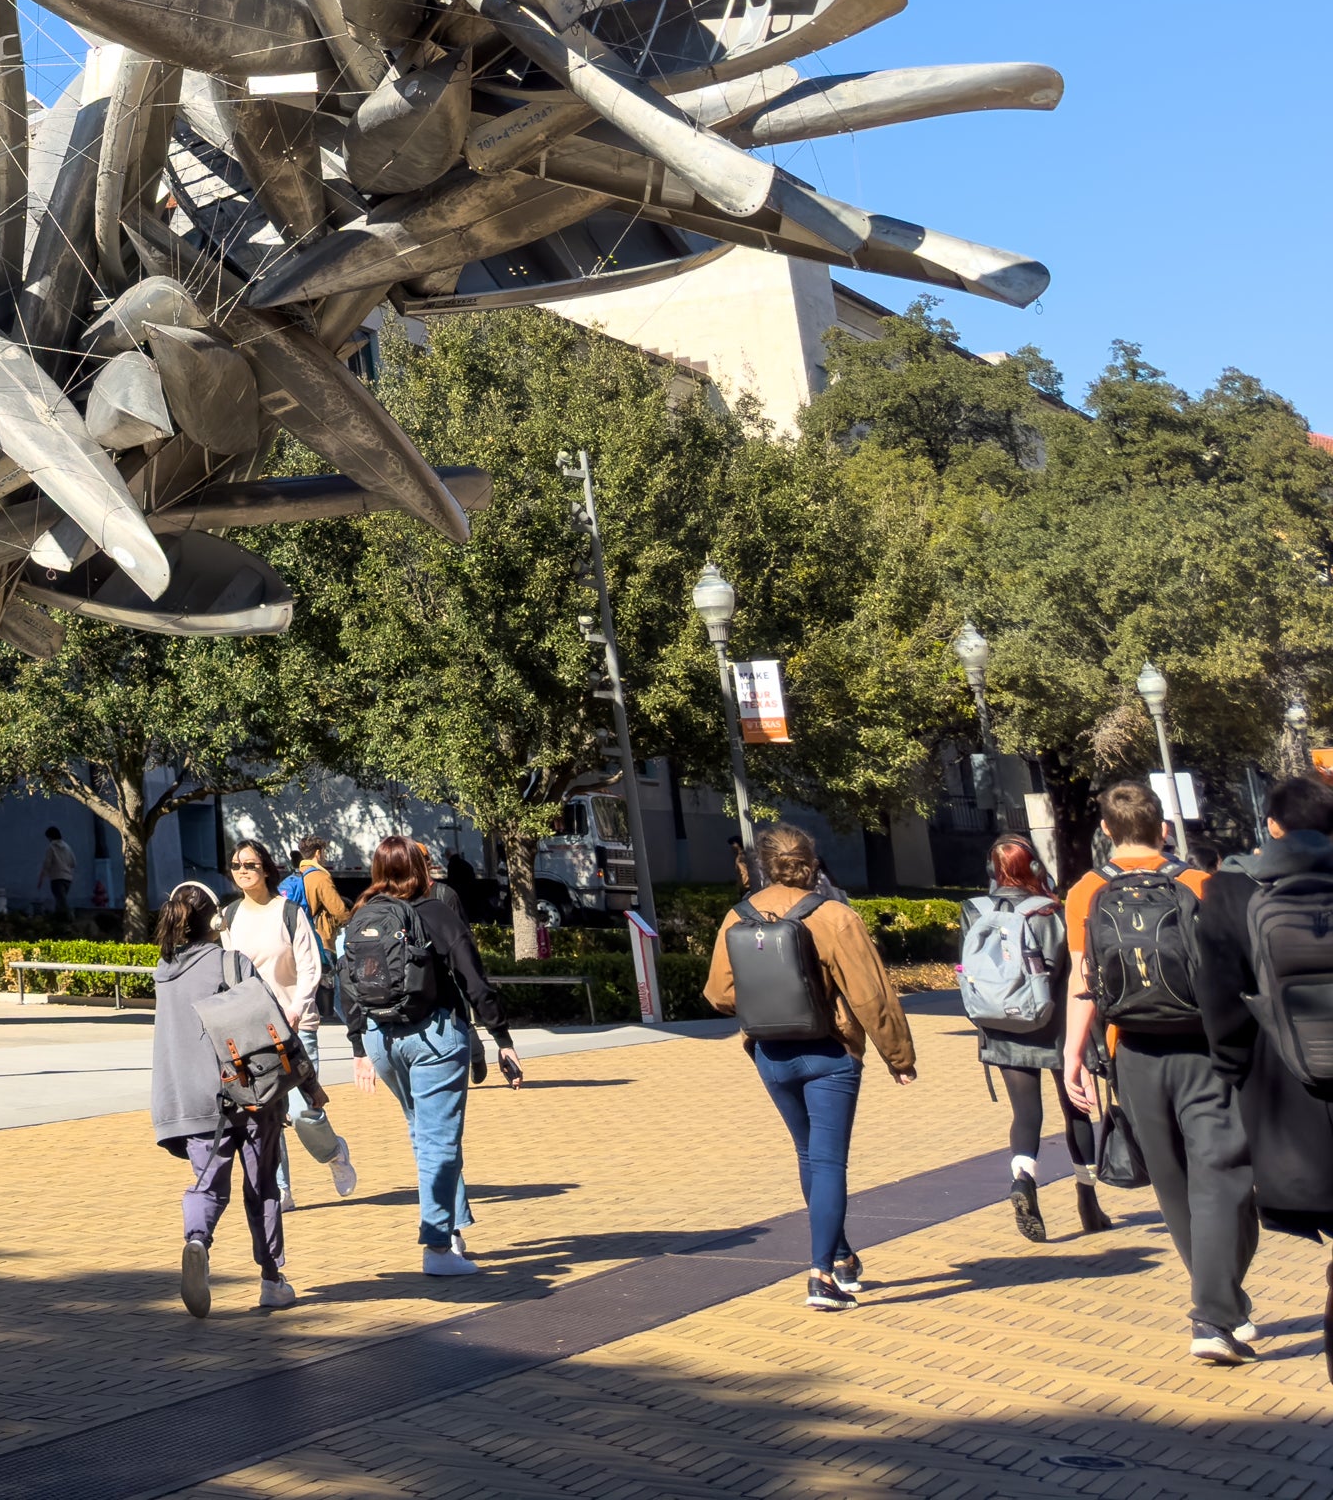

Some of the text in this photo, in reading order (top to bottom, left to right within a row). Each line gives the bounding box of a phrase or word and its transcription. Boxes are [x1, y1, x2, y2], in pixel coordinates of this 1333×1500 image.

[739, 671, 770, 680] MAKE
[740, 682, 750, 690] IT
[742, 691, 771, 699] YOUR
[742, 700, 778, 709] TEXAS
[754, 720, 782, 730] TEXAS
